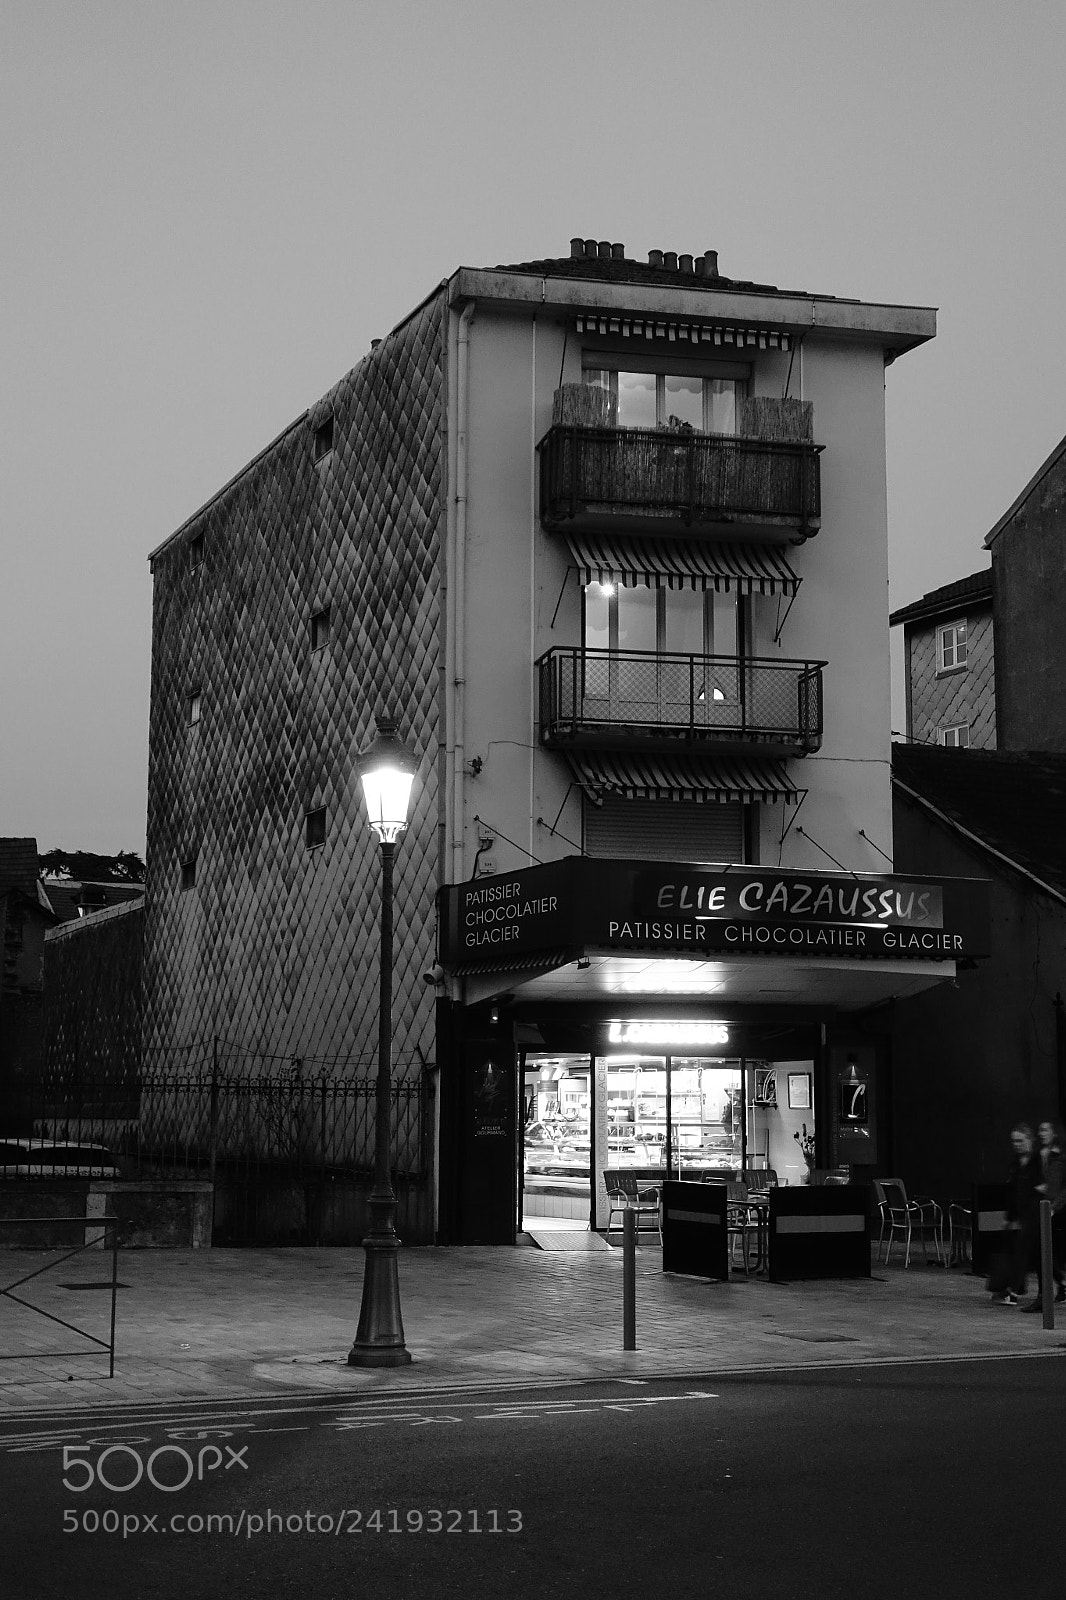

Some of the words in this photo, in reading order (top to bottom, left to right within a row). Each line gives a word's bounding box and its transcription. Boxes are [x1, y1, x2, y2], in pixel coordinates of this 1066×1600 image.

[465, 882, 521, 907] PATISSIER
[657, 884, 727, 911] ELIE
[738, 881, 931, 921] CAZAUSSUS
[465, 896, 558, 927] CHOCOLATIER
[465, 925, 520, 947] GLACIER
[609, 921, 706, 941] PATISSIER
[724, 925, 866, 946] CHOCOLATIER
[883, 932, 963, 950] GLACIER
